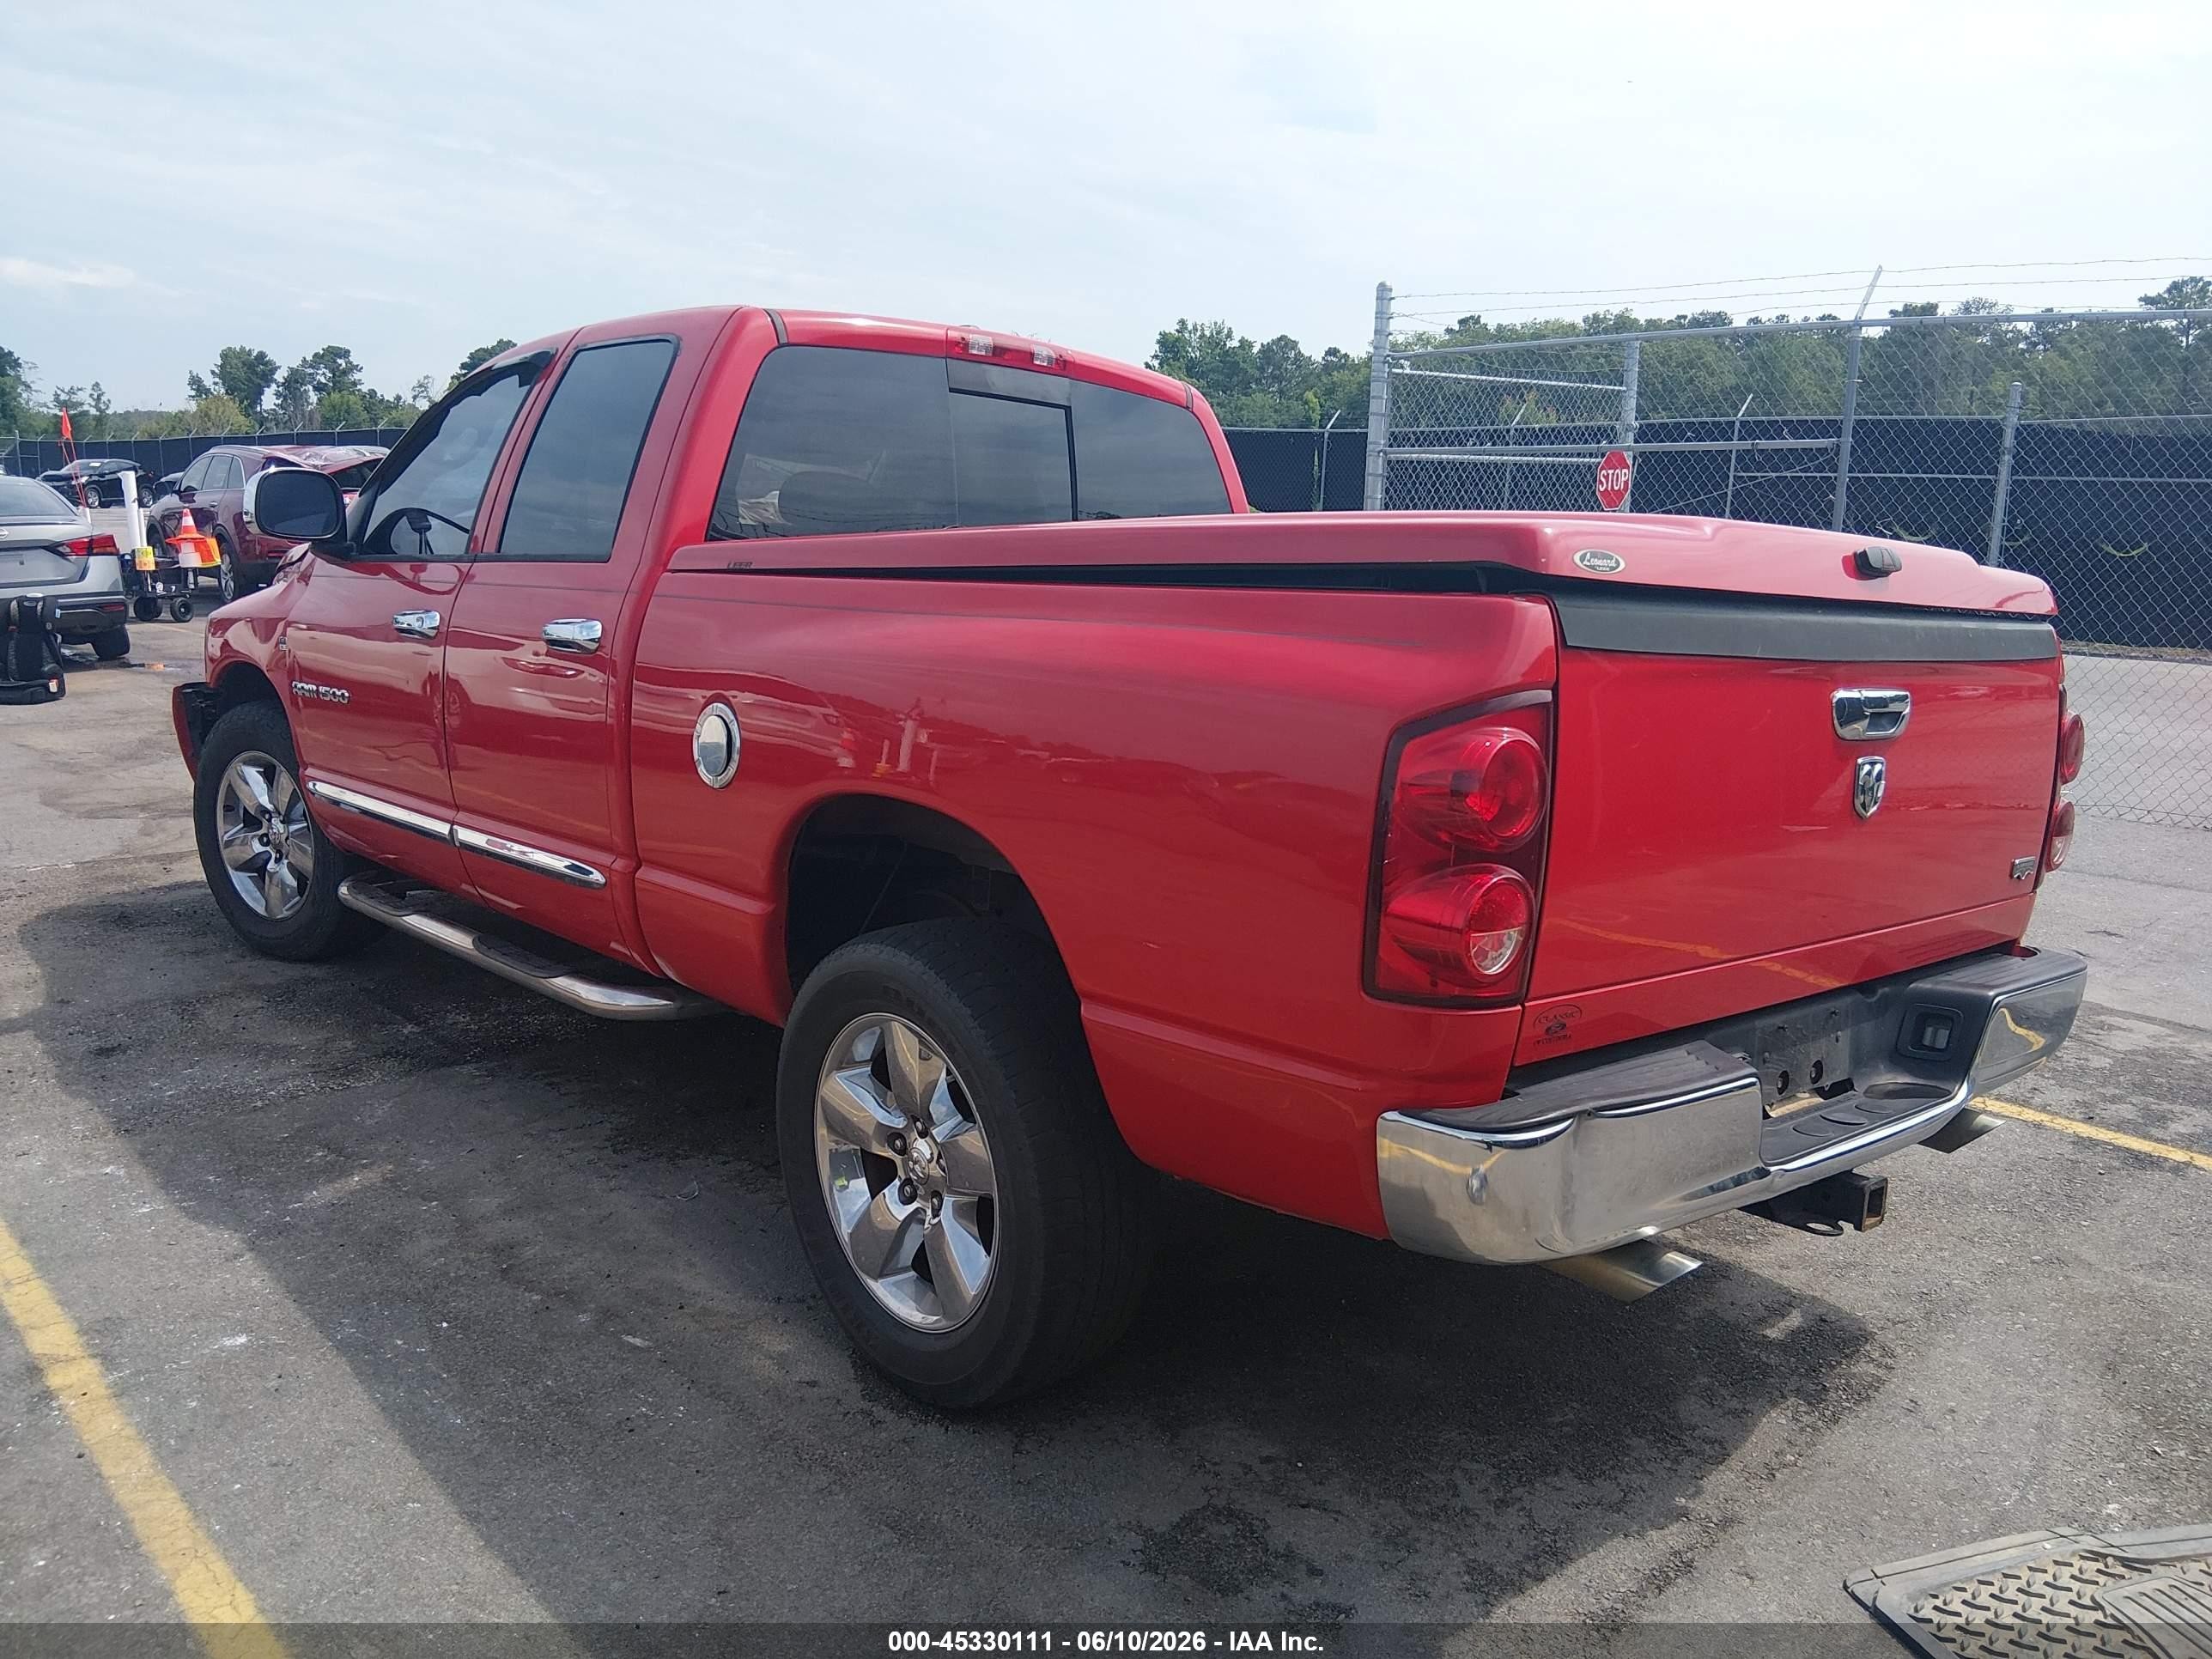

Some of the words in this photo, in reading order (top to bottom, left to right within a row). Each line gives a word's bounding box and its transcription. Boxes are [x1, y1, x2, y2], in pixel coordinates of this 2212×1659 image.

[1599, 468, 1629, 492] STOP
[1583, 552, 1618, 568] Leonard
[292, 681, 317, 699] RAM
[319, 686, 349, 704] 1500
